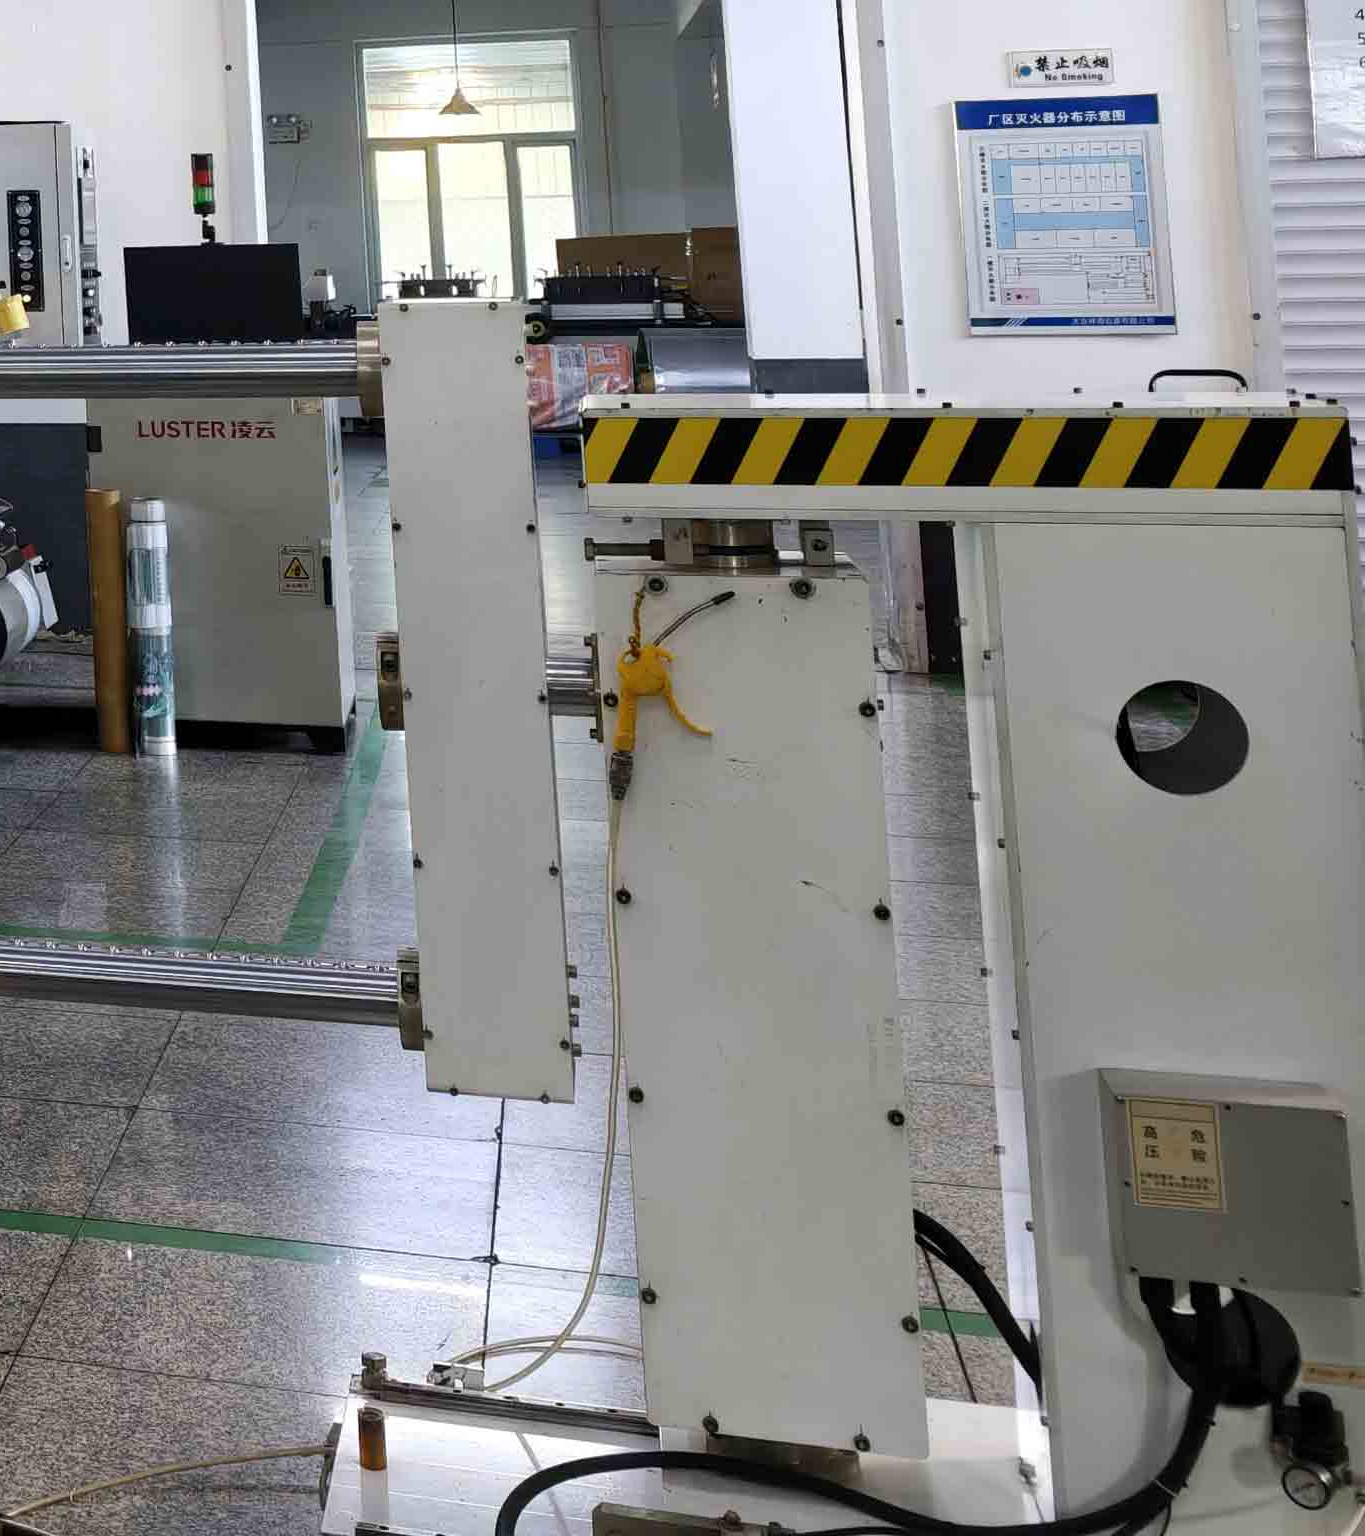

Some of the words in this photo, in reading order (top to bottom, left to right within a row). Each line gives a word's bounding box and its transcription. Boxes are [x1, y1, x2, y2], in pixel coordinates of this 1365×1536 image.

[1035, 55, 1109, 72] 禁止吸烟
[1062, 73, 1103, 81] Smoking
[988, 109, 1126, 126] 厂区灭火器分布示意图
[137, 420, 226, 439] LUSTER
[231, 421, 276, 439] 凌云
[1141, 1125, 1159, 1159] 高压
[1190, 1129, 1207, 1163] 危险
